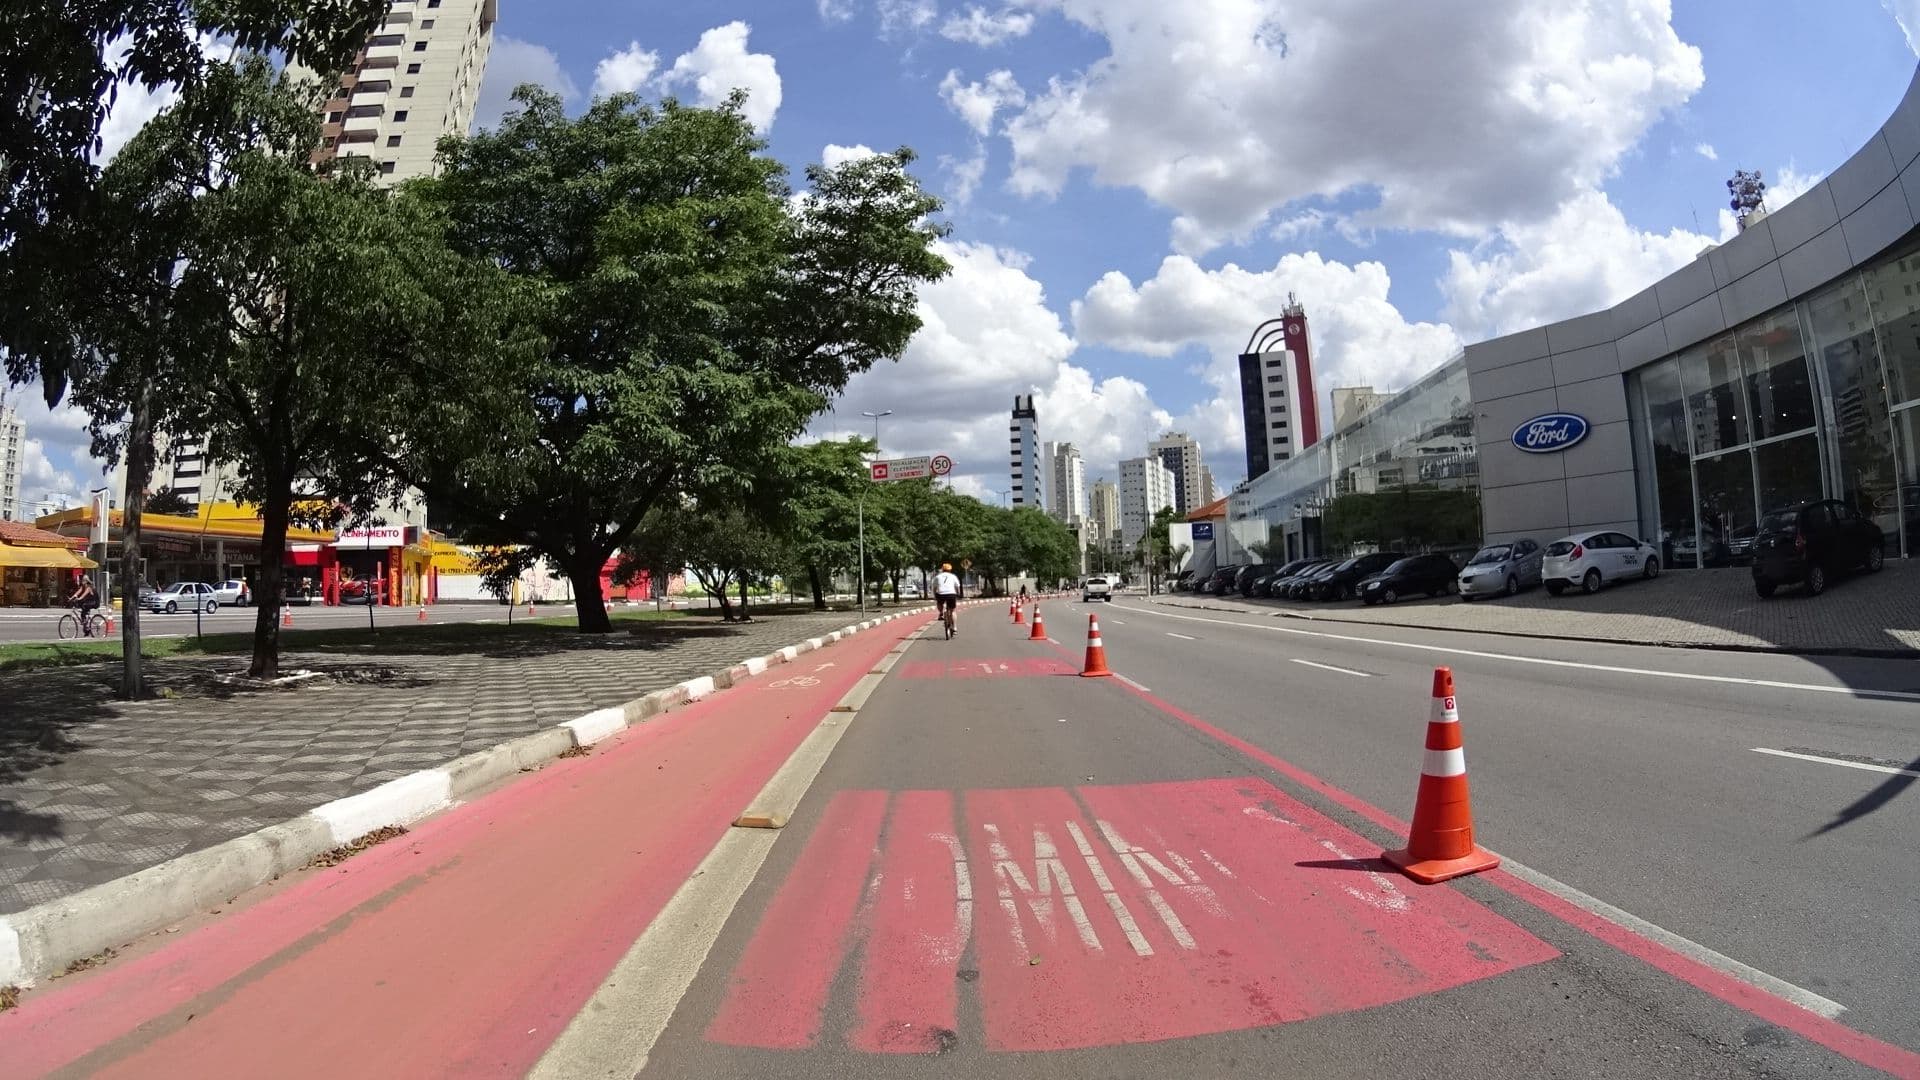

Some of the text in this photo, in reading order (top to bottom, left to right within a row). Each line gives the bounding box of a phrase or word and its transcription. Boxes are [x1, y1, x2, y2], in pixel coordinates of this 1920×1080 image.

[1526, 419, 1569, 446] Ford
[935, 459, 949, 470] 50
[341, 529, 399, 538] ALINHAMENTO
[215, 553, 255, 561] NTANA
